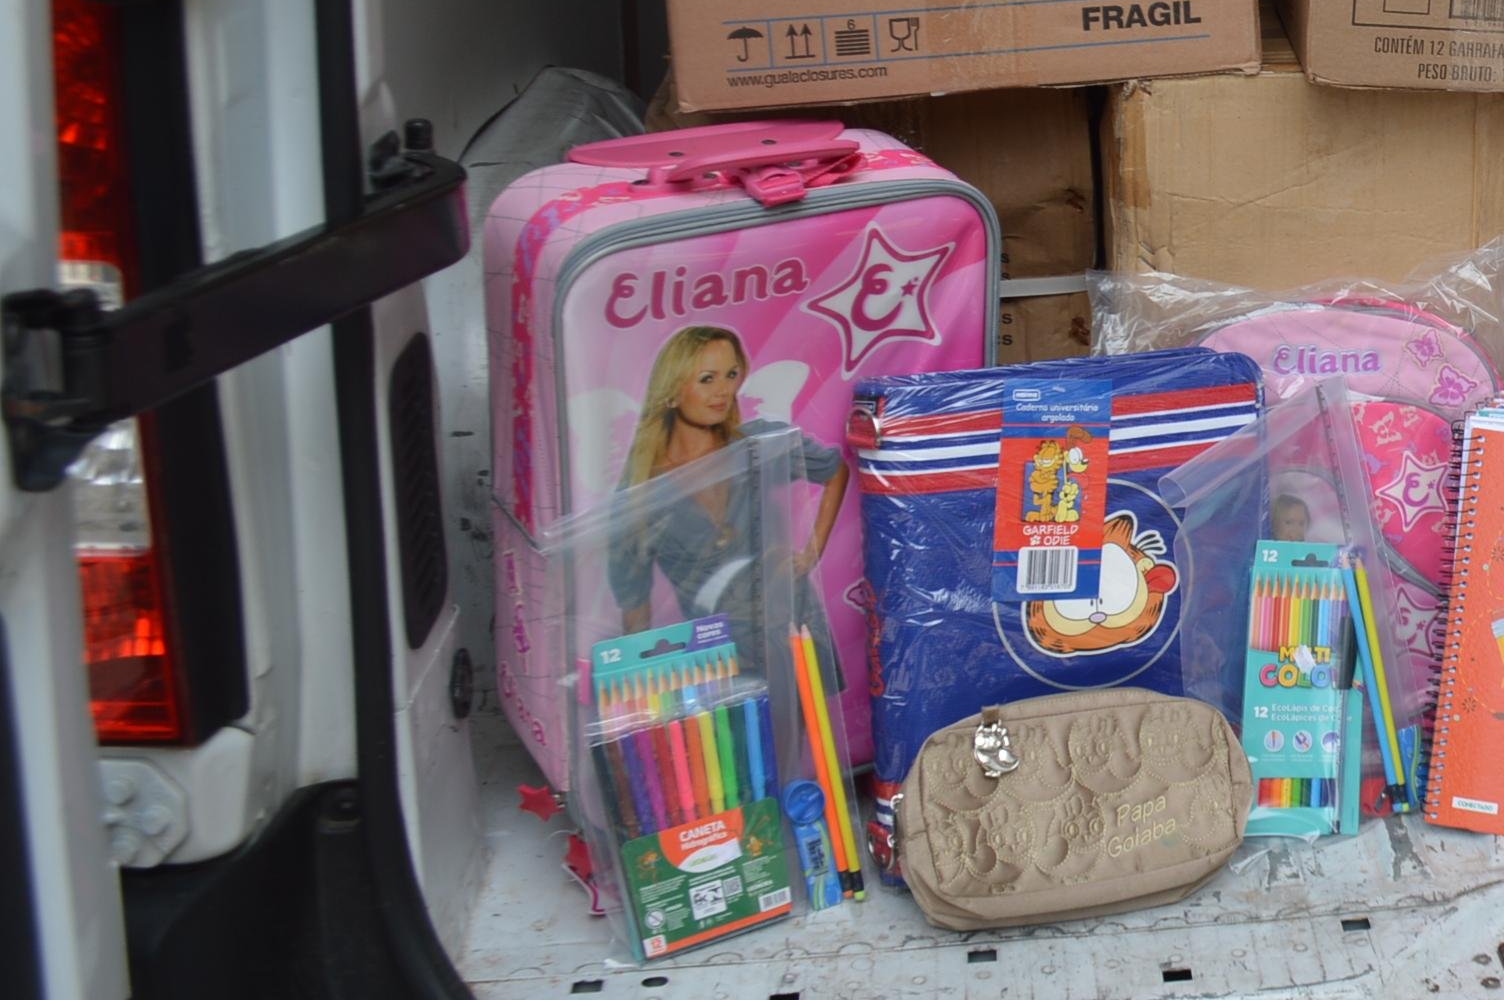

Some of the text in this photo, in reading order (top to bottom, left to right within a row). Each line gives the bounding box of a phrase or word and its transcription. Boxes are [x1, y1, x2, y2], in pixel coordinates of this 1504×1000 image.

[846, 19, 855, 31] 6
[1082, 0, 1203, 32] FRAGIL
[1374, 34, 1425, 56] CONTÉM
[1429, 39, 1445, 56] 12
[726, 64, 888, 89] www.gualaclosures.com
[1417, 63, 1448, 81] PESO
[1450, 64, 1497, 83] BRUTO:
[604, 256, 809, 330] Eliana
[1273, 347, 1381, 376] Eliana
[1022, 524, 1079, 536] GARFIELD
[1043, 535, 1071, 546] ODIE
[1262, 549, 1278, 562] 12
[600, 647, 622, 665] 12
[1279, 645, 1332, 664] MTI
[1253, 705, 1269, 719] 12
[1116, 795, 1167, 827] Papa
[679, 819, 727, 842] CANETA
[1107, 817, 1177, 858] Goiaba
